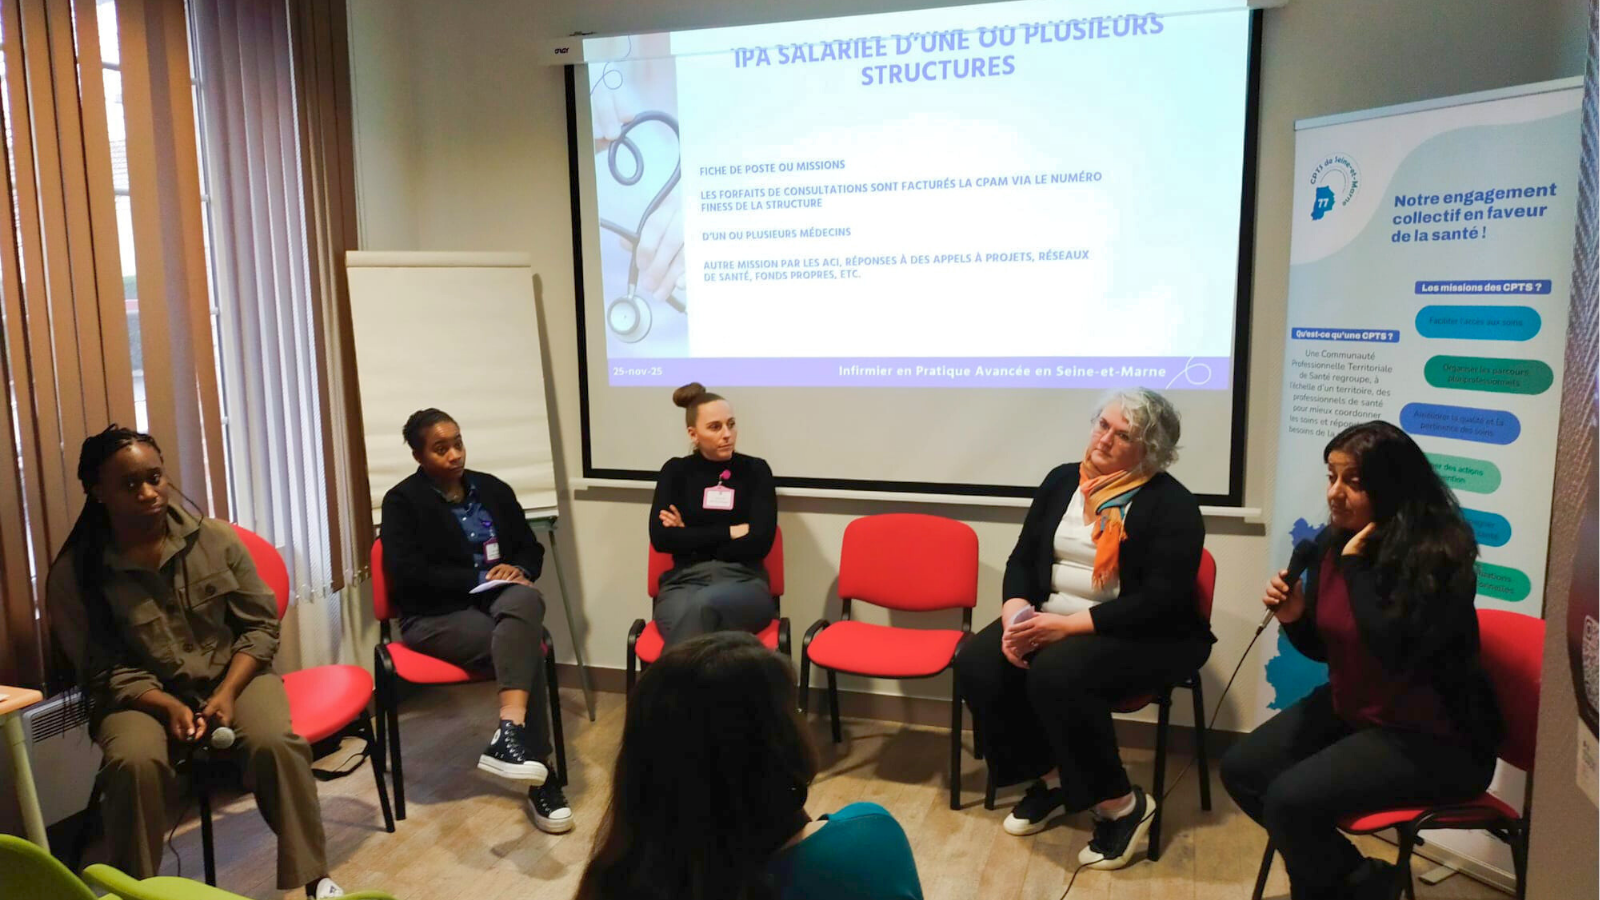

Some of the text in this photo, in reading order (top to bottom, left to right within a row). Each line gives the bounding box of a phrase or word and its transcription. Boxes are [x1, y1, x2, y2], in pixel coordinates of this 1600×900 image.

[731, 46, 770, 68] IPA
[976, 25, 1016, 48] OU
[1020, 12, 1164, 44] PLUSIEURS
[861, 55, 1015, 86] STRUCTURES
[700, 160, 846, 176] FICHE DE POSTE OU MISSIONS
[701, 170, 1102, 200] LES FORFAITS DE CONSULTATIONS SONT FACTURÉS LA CPAM VIA LE NUMÉRO
[1394, 182, 1557, 208] Notre engagement
[701, 199, 822, 212] FINESS DE LA STRUCTURE
[1318, 198, 1329, 208] 77
[1392, 205, 1548, 225] collectif en faveur
[729, 231, 743, 240] OU
[746, 229, 797, 240] PLUSIEURS
[800, 226, 851, 238] MÉDECINS
[1392, 226, 1487, 242] de la santé !
[704, 249, 1090, 270] AUTRE MISSION PAR LES ACI, RÉPONSES À DES APPELS À PROJETS, RÉSEAUX
[704, 270, 862, 282] DE SANTÉ, FONDS PROPRES, ETC.
[1422, 282, 1542, 292] Les missions des CPTS ?
[1362, 332, 1387, 340] CPTS
[1388, 332, 1394, 340] ?
[1305, 350, 1376, 360] Une Communauté
[613, 366, 663, 376] 25-nov-25
[838, 364, 1167, 380] Infirmier en Pratique Avancée en Seine-et-Marne
[1292, 360, 1393, 373] Professionnelle Territoriale
[1309, 372, 1330, 380] Santé
[1332, 374, 1372, 385] regroupe,
[1336, 386, 1374, 396] territoire,
[1376, 388, 1391, 397] des
[1292, 394, 1384, 408] professionnels de santé
[1290, 414, 1298, 422] les
[1300, 416, 1318, 424] soins
[1310, 406, 1332, 414] mieux
[1334, 408, 1382, 419] coordonner
[1288, 426, 1336, 438] besoins de la
[1458, 466, 1484, 476] actions
